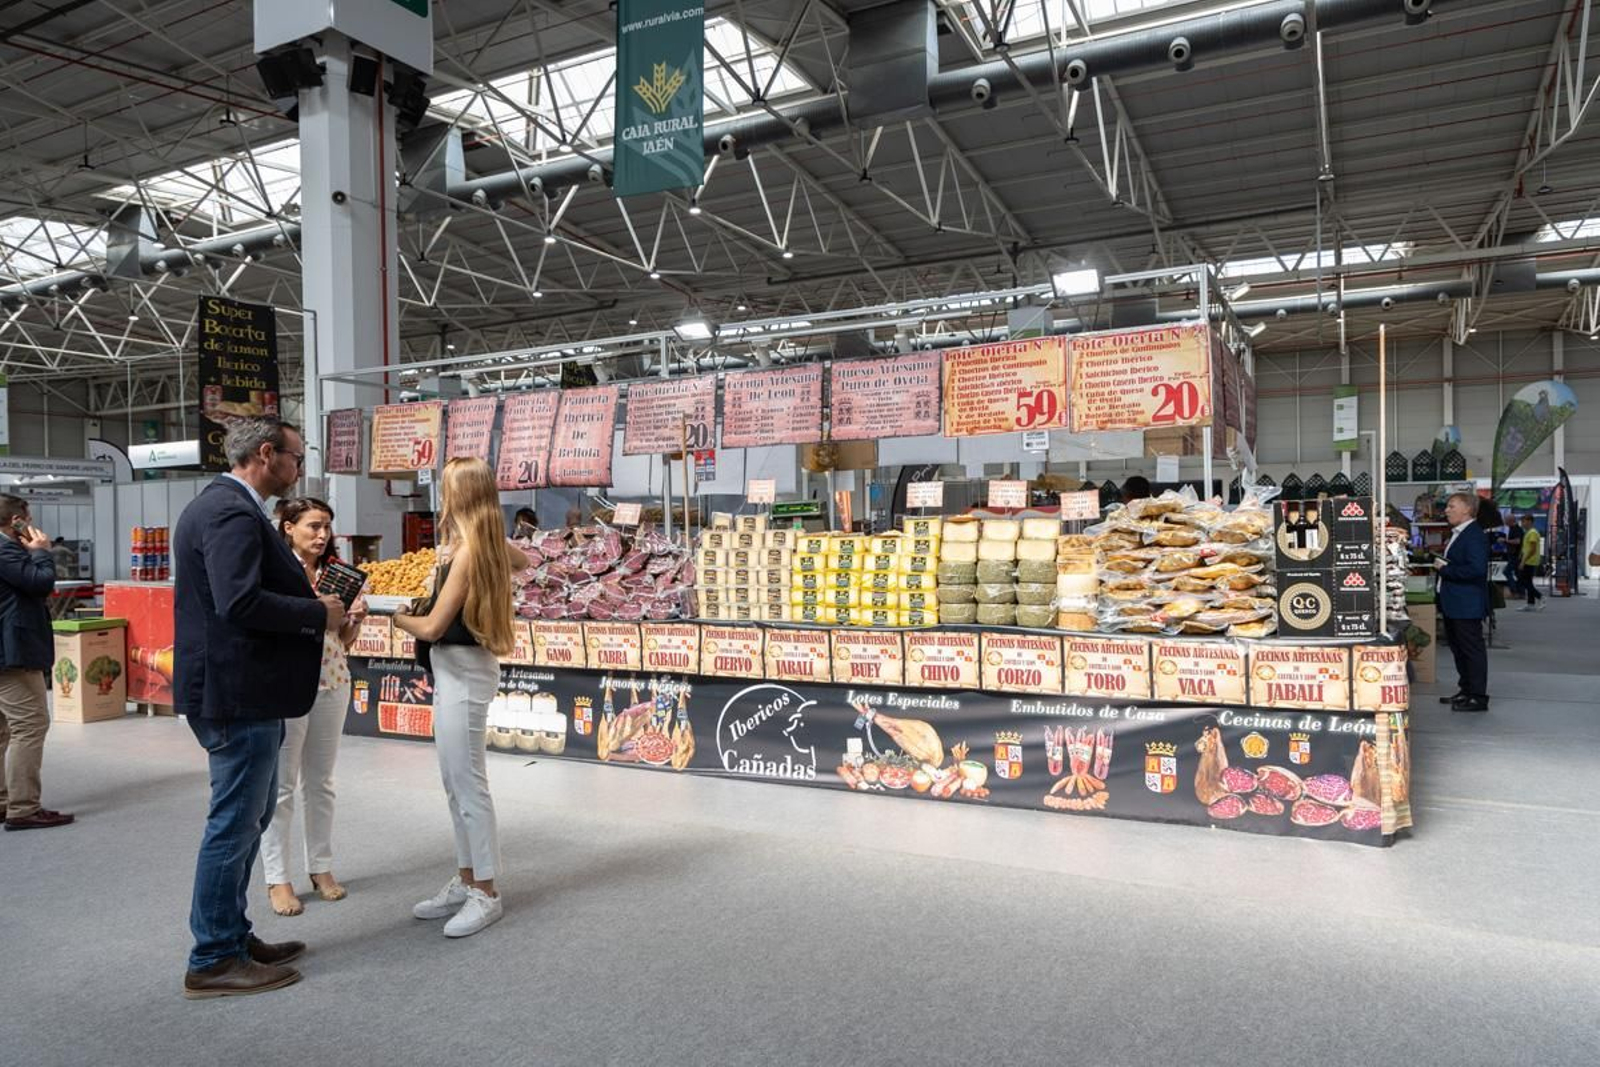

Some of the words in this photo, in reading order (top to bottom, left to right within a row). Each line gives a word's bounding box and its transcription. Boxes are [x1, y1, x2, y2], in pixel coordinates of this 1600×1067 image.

[622, 6, 704, 34] www.ruralvia.com
[622, 125, 651, 141] CAJA
[654, 115, 698, 134] RURAL
[642, 137, 675, 156] JAÉN
[207, 299, 253, 321] Super
[204, 339, 224, 351] de
[1073, 340, 1105, 351] Lote
[1112, 332, 1163, 347] Oferta
[945, 351, 975, 361] Lote
[981, 343, 1027, 357] Oferta
[838, 367, 874, 379] Queso
[880, 362, 932, 375] Artesano
[1086, 359, 1118, 368] Chorizo
[728, 379, 764, 389] Cecina
[769, 374, 819, 386] Artesana
[841, 381, 870, 391] Puro
[874, 378, 889, 388] de
[894, 375, 928, 385] Oveja
[564, 395, 609, 406] Panceta
[558, 447, 600, 458] Bellota
[837, 634, 860, 644] CECINAS
[861, 635, 898, 646] ARTESANAS
[910, 635, 935, 646] CECINAS
[937, 636, 974, 647] ARTESANAS
[987, 638, 1015, 649] CECINAS
[1016, 639, 1056, 651] ARTESANAS
[1070, 642, 1099, 653] CECINAS
[1101, 643, 1144, 655] ARTESANAS
[546, 647, 572, 662] GAMO
[598, 650, 628, 665] CABRA
[649, 651, 689, 668] CABALLO
[1159, 646, 1191, 658] CECINAS
[1192, 646, 1239, 660] ARTESANAS
[1256, 650, 1290, 662] CECINAS
[1292, 652, 1343, 663] ARTESANAS
[1361, 651, 1395, 662] CECINAS
[714, 655, 753, 672] CIERVO
[775, 658, 814, 677] JABALÍ
[850, 662, 882, 678] BUEY
[509, 666, 554, 681] Artesanos
[920, 664, 960, 682] CHIVO
[997, 667, 1042, 686] CORZO
[1084, 672, 1126, 691] TORO
[508, 680, 517, 688] de
[518, 681, 539, 691] Oveja
[1177, 677, 1217, 696] VACA
[1266, 680, 1324, 704] JABALÍ
[1381, 684, 1408, 704] BUE
[847, 690, 882, 705] Lotes
[886, 692, 960, 710] Especiales
[729, 692, 790, 742] Ibericos
[1011, 700, 1094, 717] Embutidos
[1099, 705, 1119, 718] de
[1124, 707, 1165, 721] Caza
[1220, 710, 1291, 729] Cecinas
[1298, 714, 1322, 731] de
[1328, 716, 1377, 734] León
[723, 749, 817, 780] Cañadas
